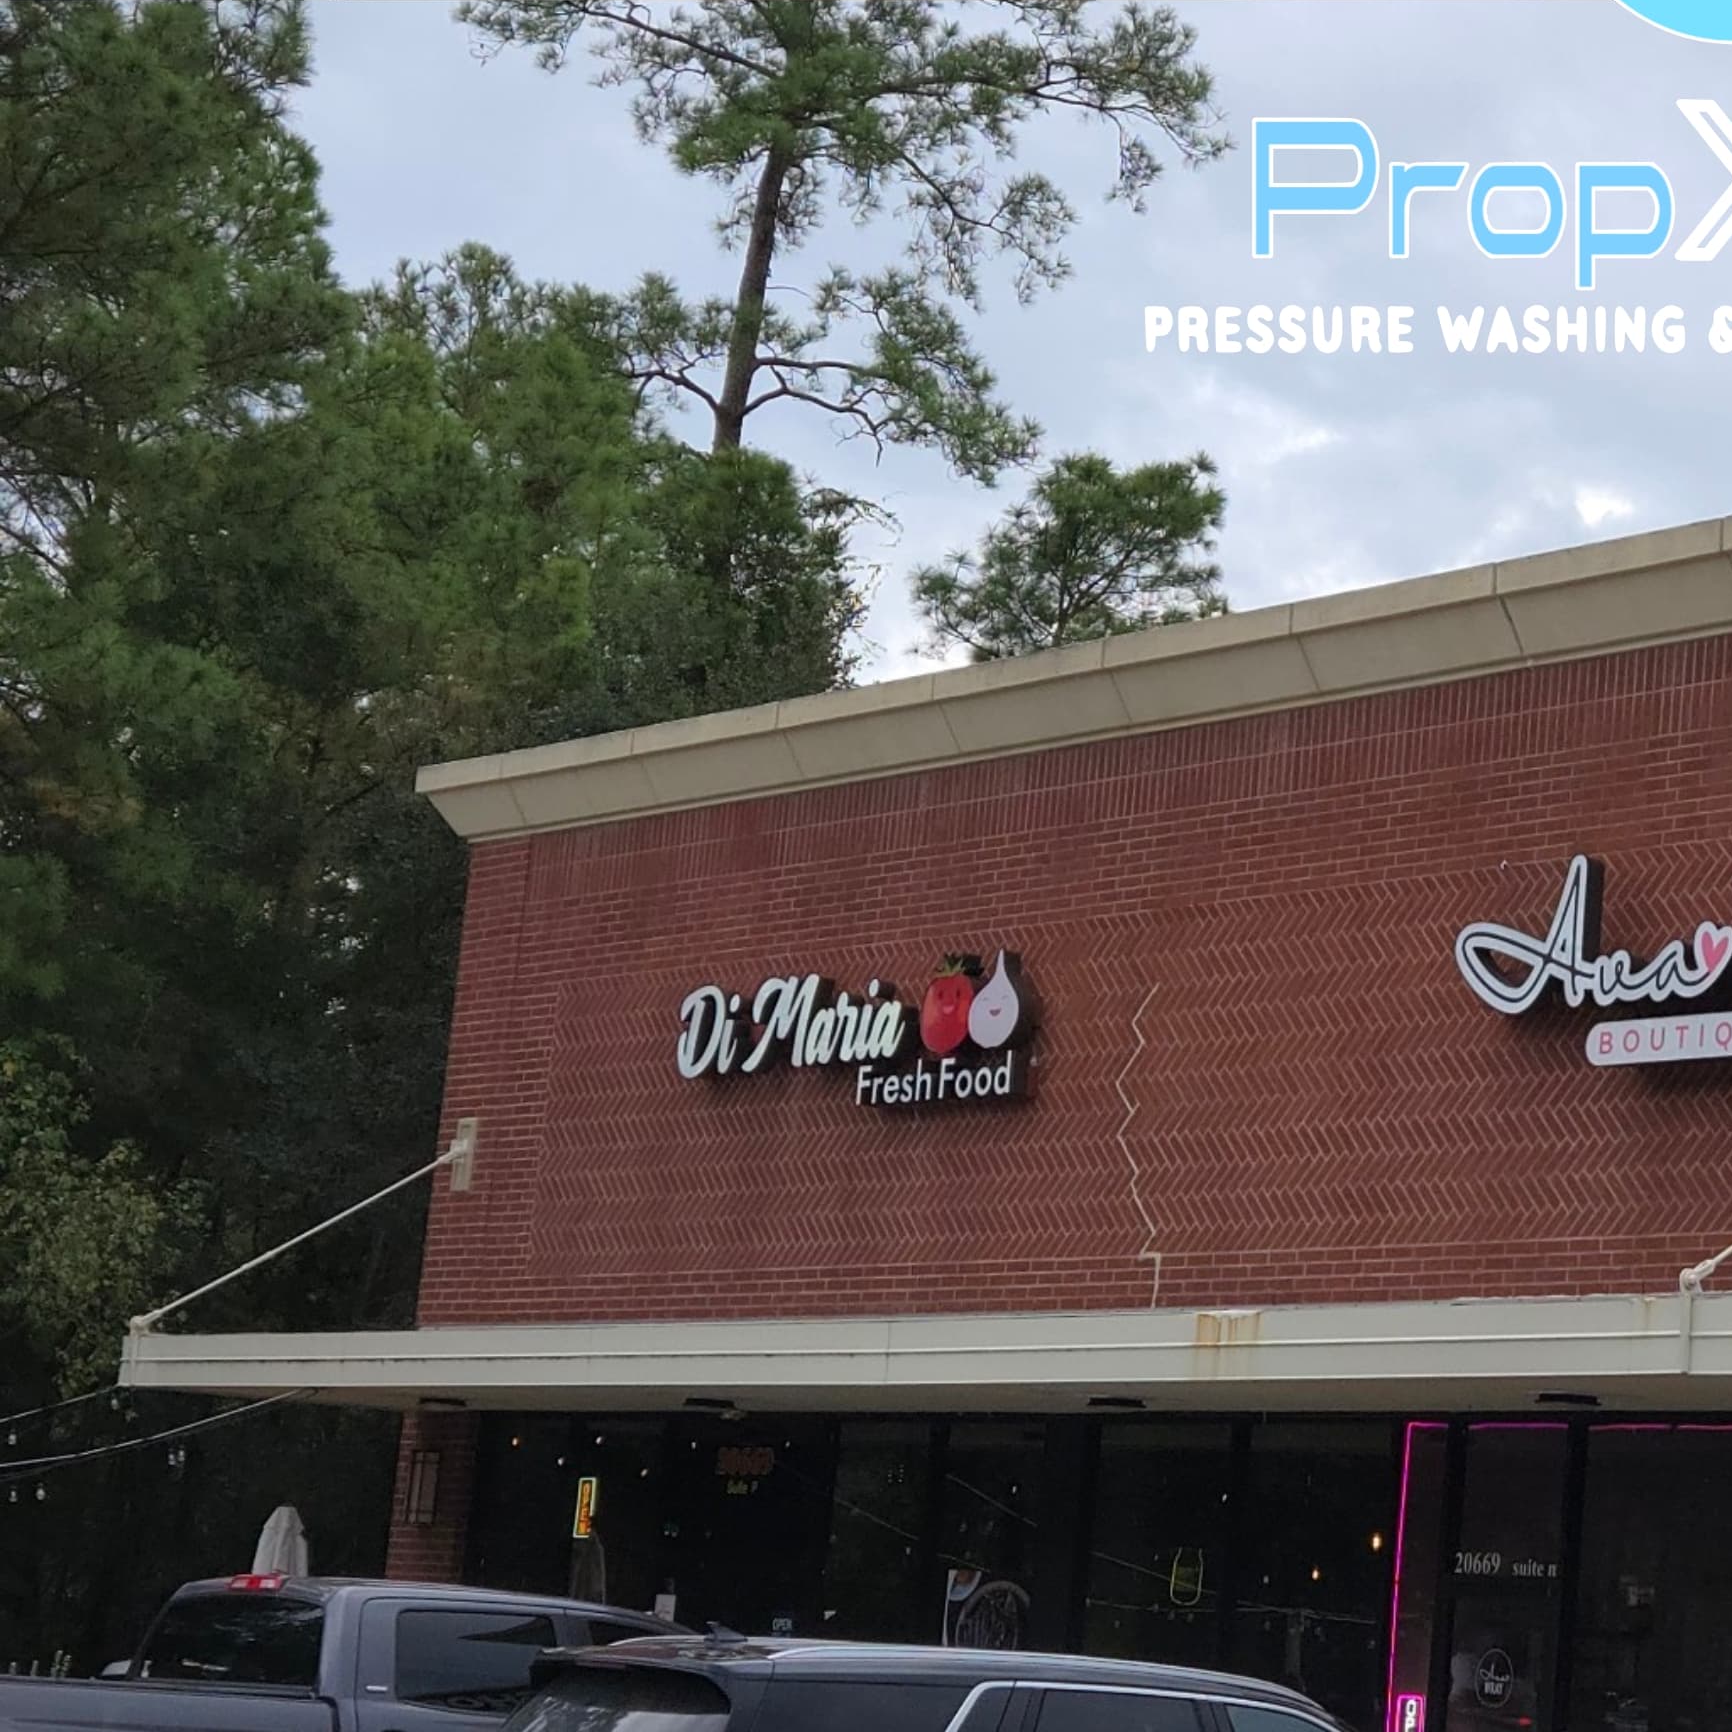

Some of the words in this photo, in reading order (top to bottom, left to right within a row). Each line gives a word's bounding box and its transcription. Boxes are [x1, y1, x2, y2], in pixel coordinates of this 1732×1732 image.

[676, 985, 741, 1079] Di
[742, 973, 905, 1072] Maria
[856, 1059, 931, 1106] Fresh
[937, 1051, 1012, 1099] Food
[1454, 1551, 1501, 1575] 20669
[1512, 1558, 1545, 1577] suite
